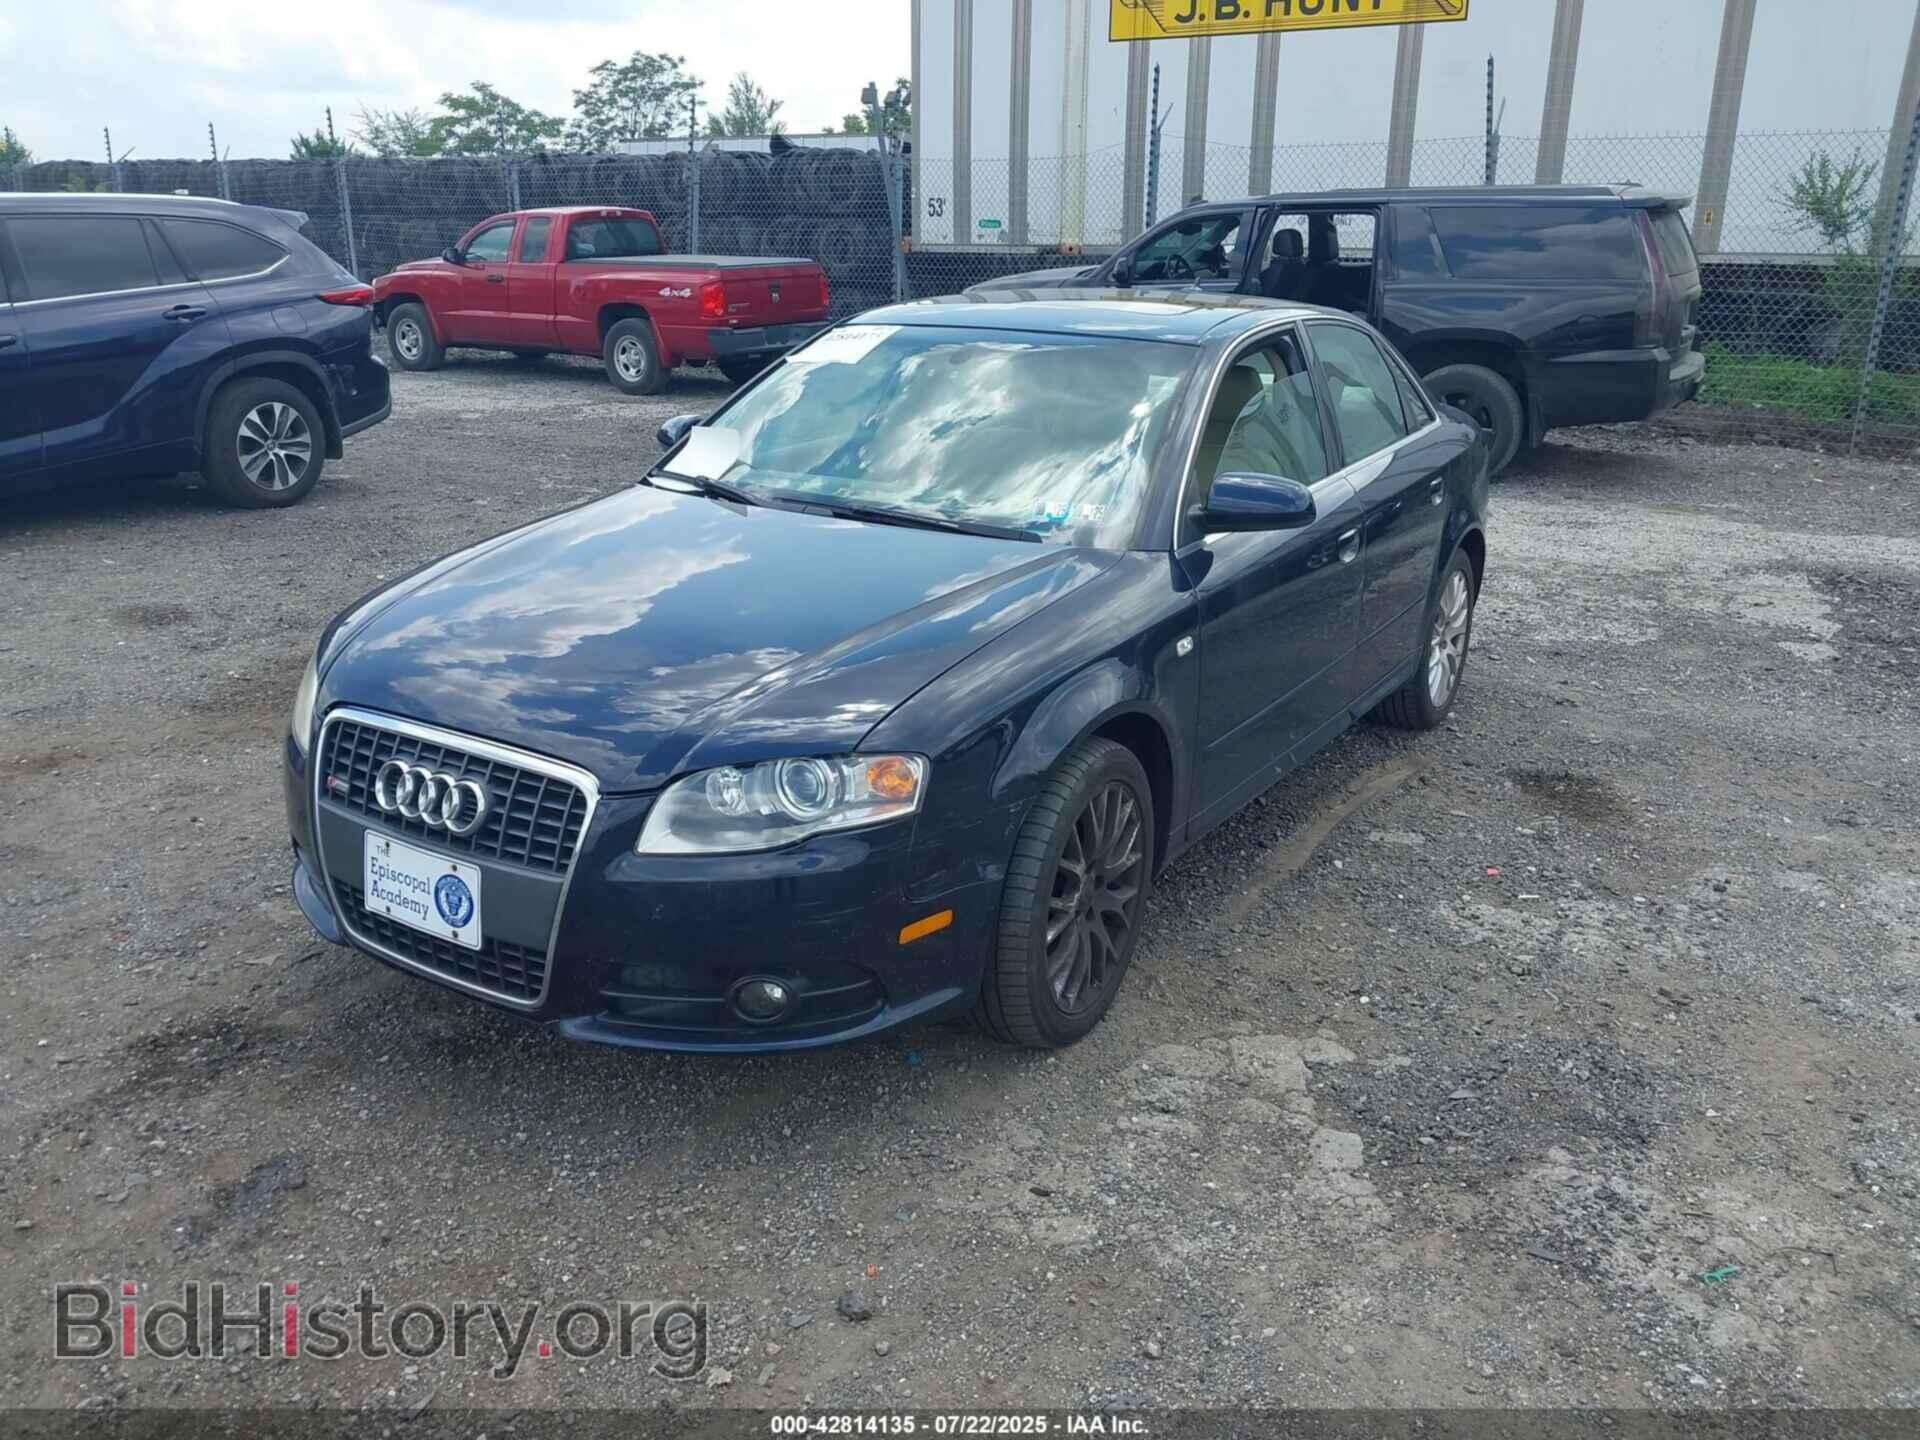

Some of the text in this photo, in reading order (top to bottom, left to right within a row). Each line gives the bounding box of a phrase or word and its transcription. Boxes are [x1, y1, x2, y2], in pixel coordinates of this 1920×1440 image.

[1174, 0, 1250, 23] J.B.
[659, 286, 693, 298] 4x4
[376, 844, 392, 858] THE
[370, 856, 431, 896] Episcopal
[370, 879, 430, 921] Academy
